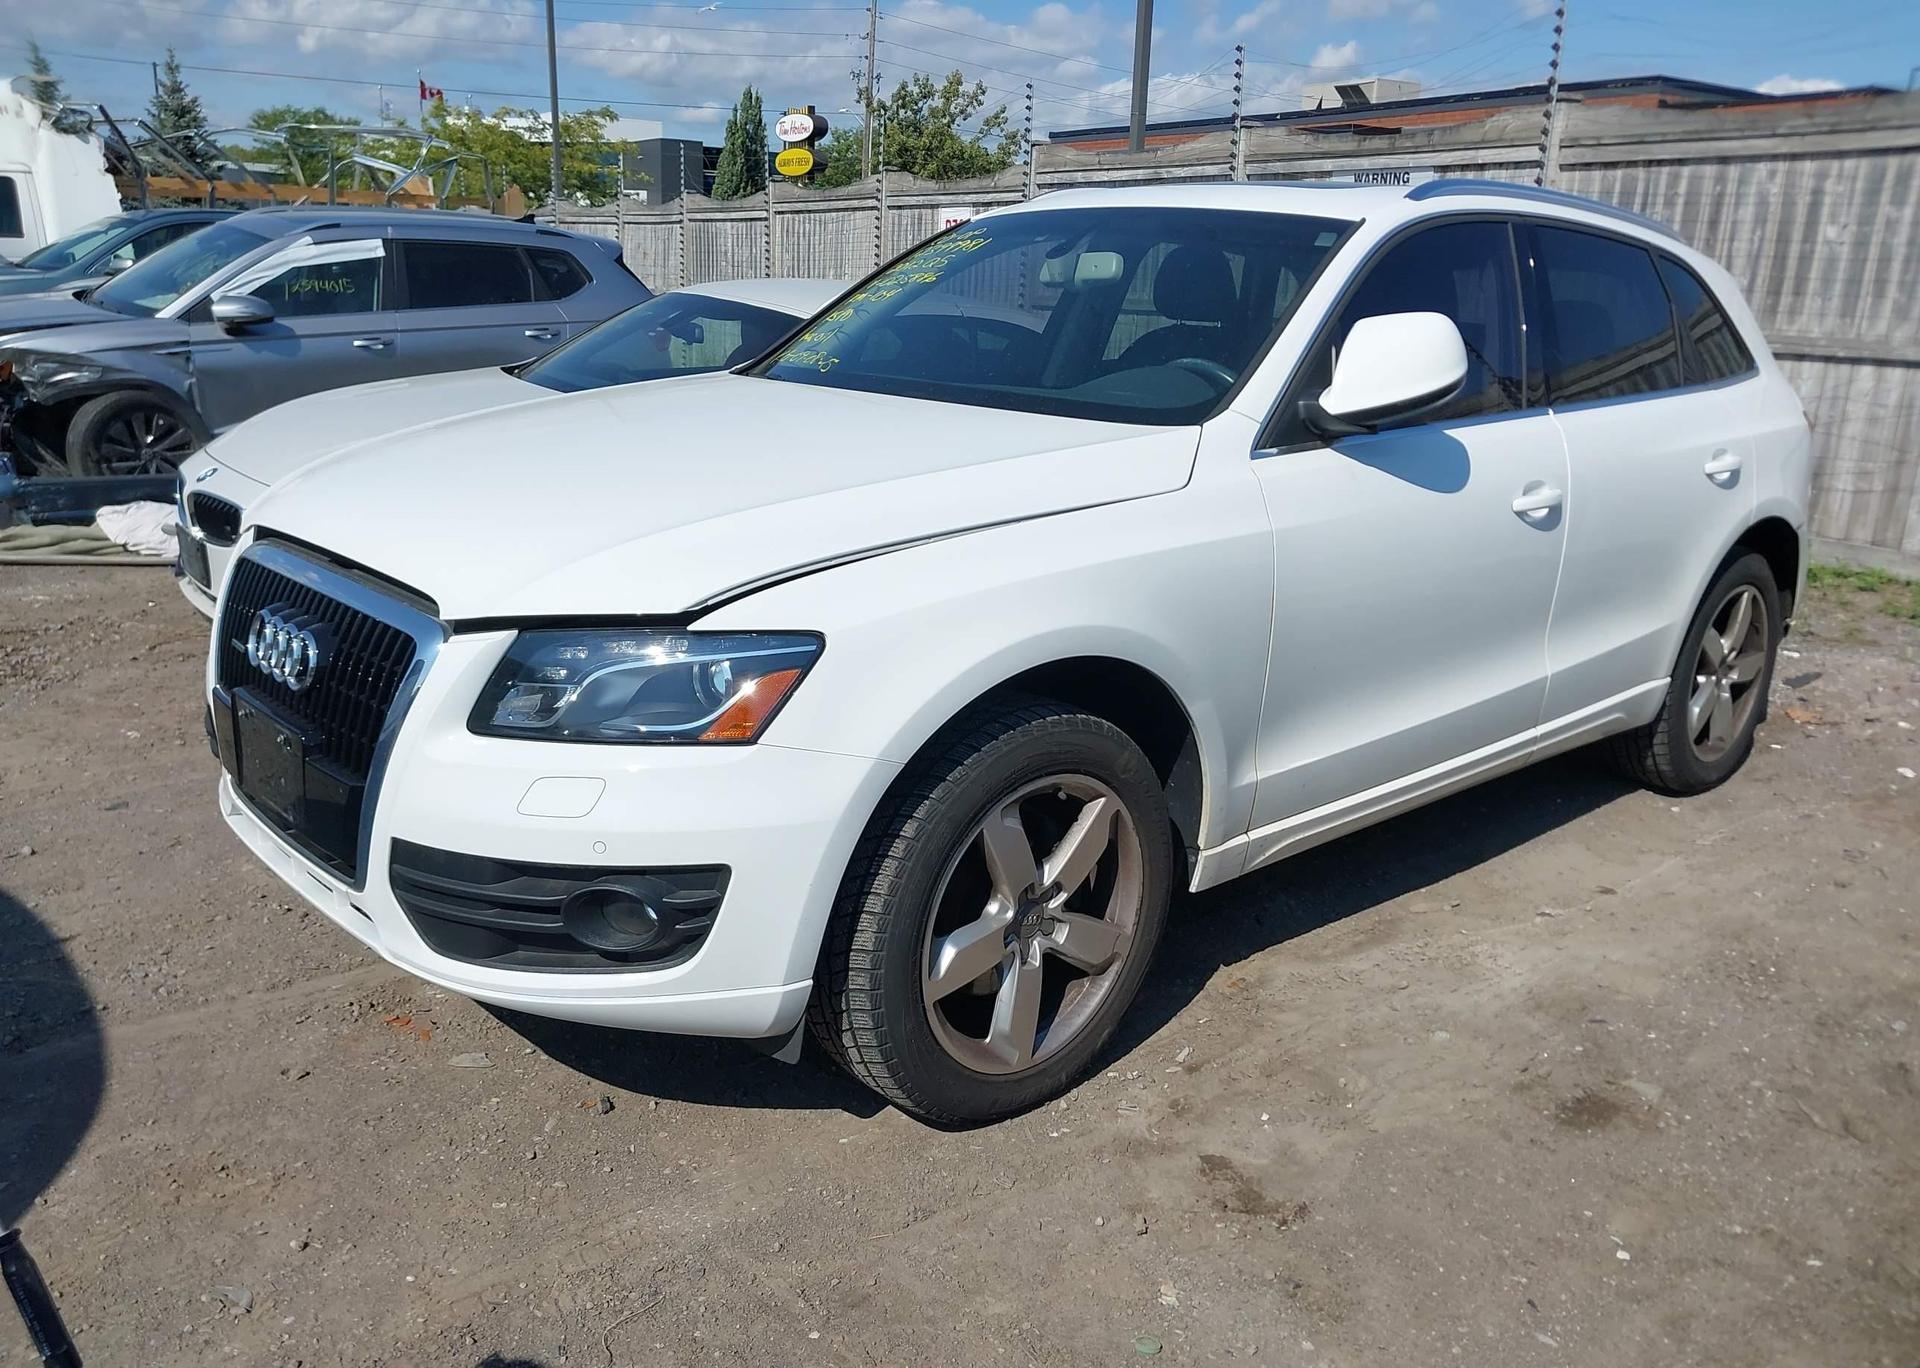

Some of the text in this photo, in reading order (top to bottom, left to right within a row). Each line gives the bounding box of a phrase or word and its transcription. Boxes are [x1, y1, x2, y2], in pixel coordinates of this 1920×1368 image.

[779, 120, 811, 136] Tim Hortons
[778, 157, 811, 168] ALWAYS FRESH
[1353, 171, 1411, 185] WARNING
